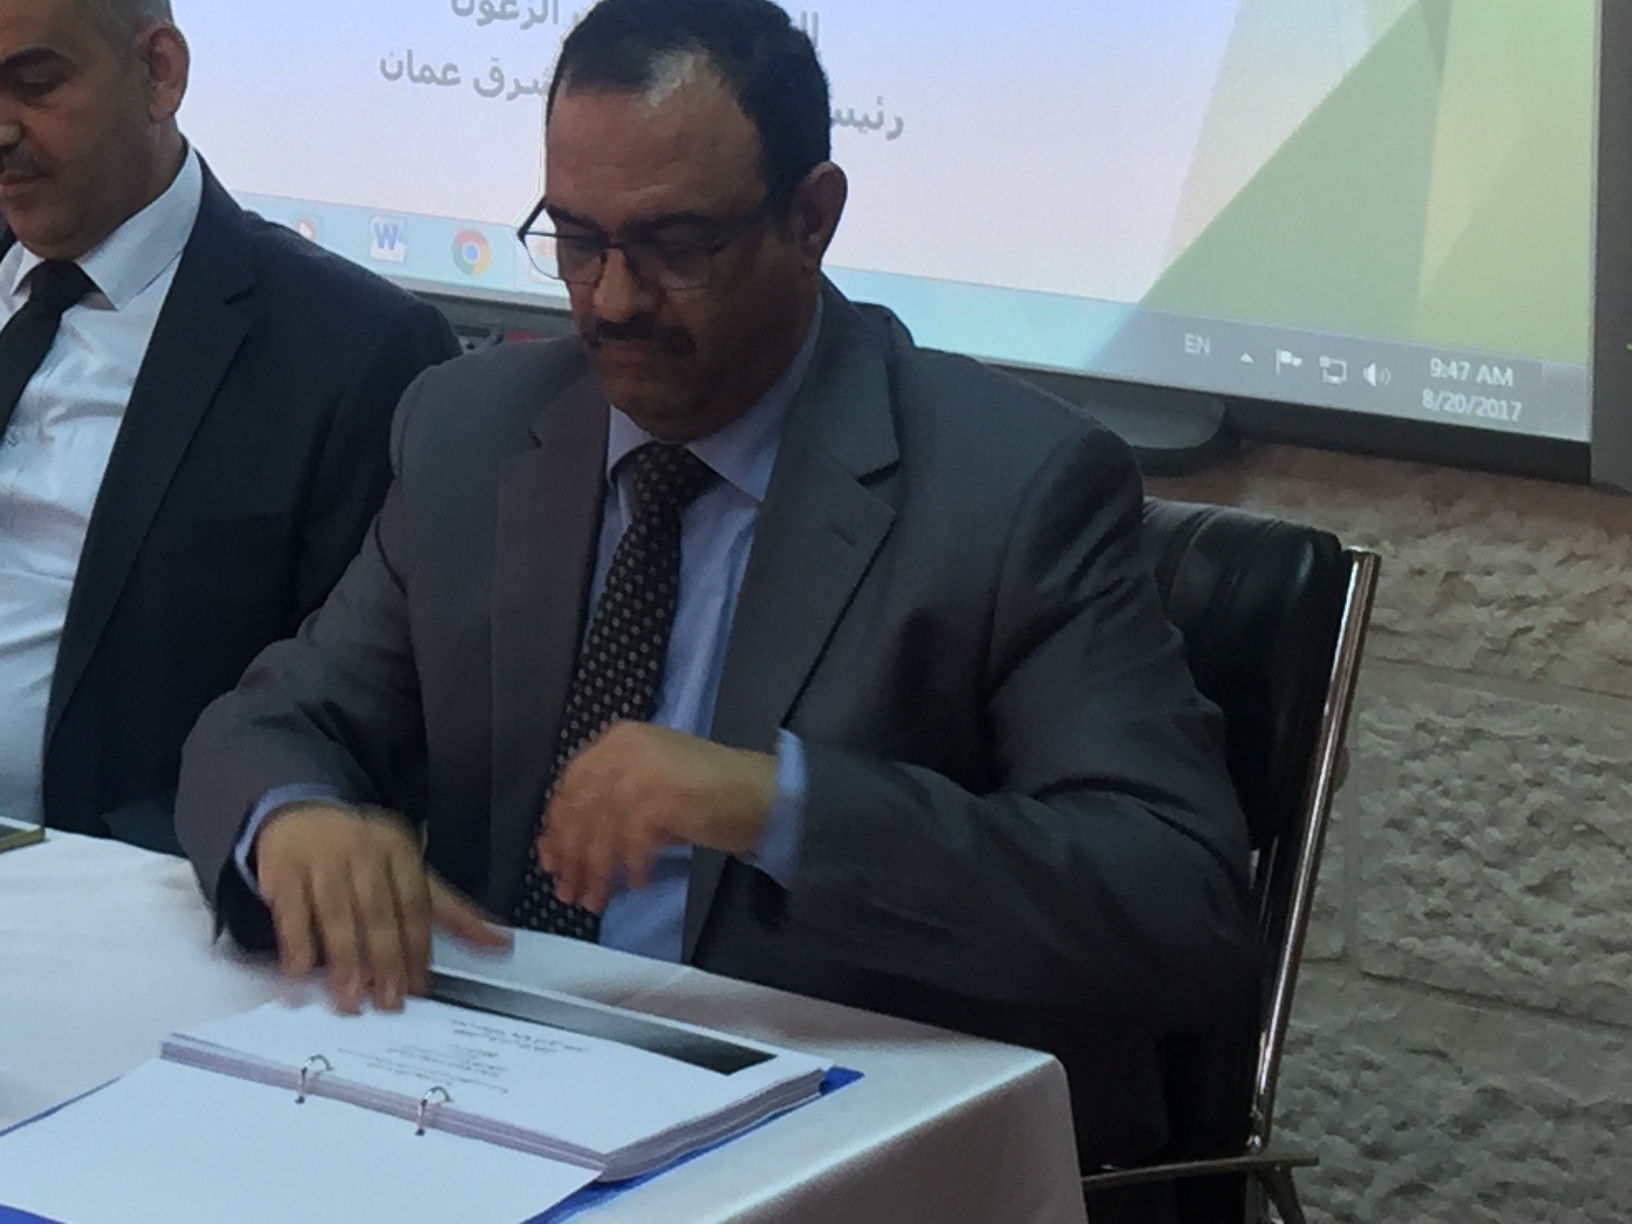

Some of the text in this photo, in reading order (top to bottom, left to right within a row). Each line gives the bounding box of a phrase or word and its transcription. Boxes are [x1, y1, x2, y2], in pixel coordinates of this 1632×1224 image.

[378, 49, 462, 88] عمان
[1184, 333, 1211, 356] EN
[1429, 357, 1514, 387] 9:47 AM
[1422, 388, 1523, 422] 8/20/2017
